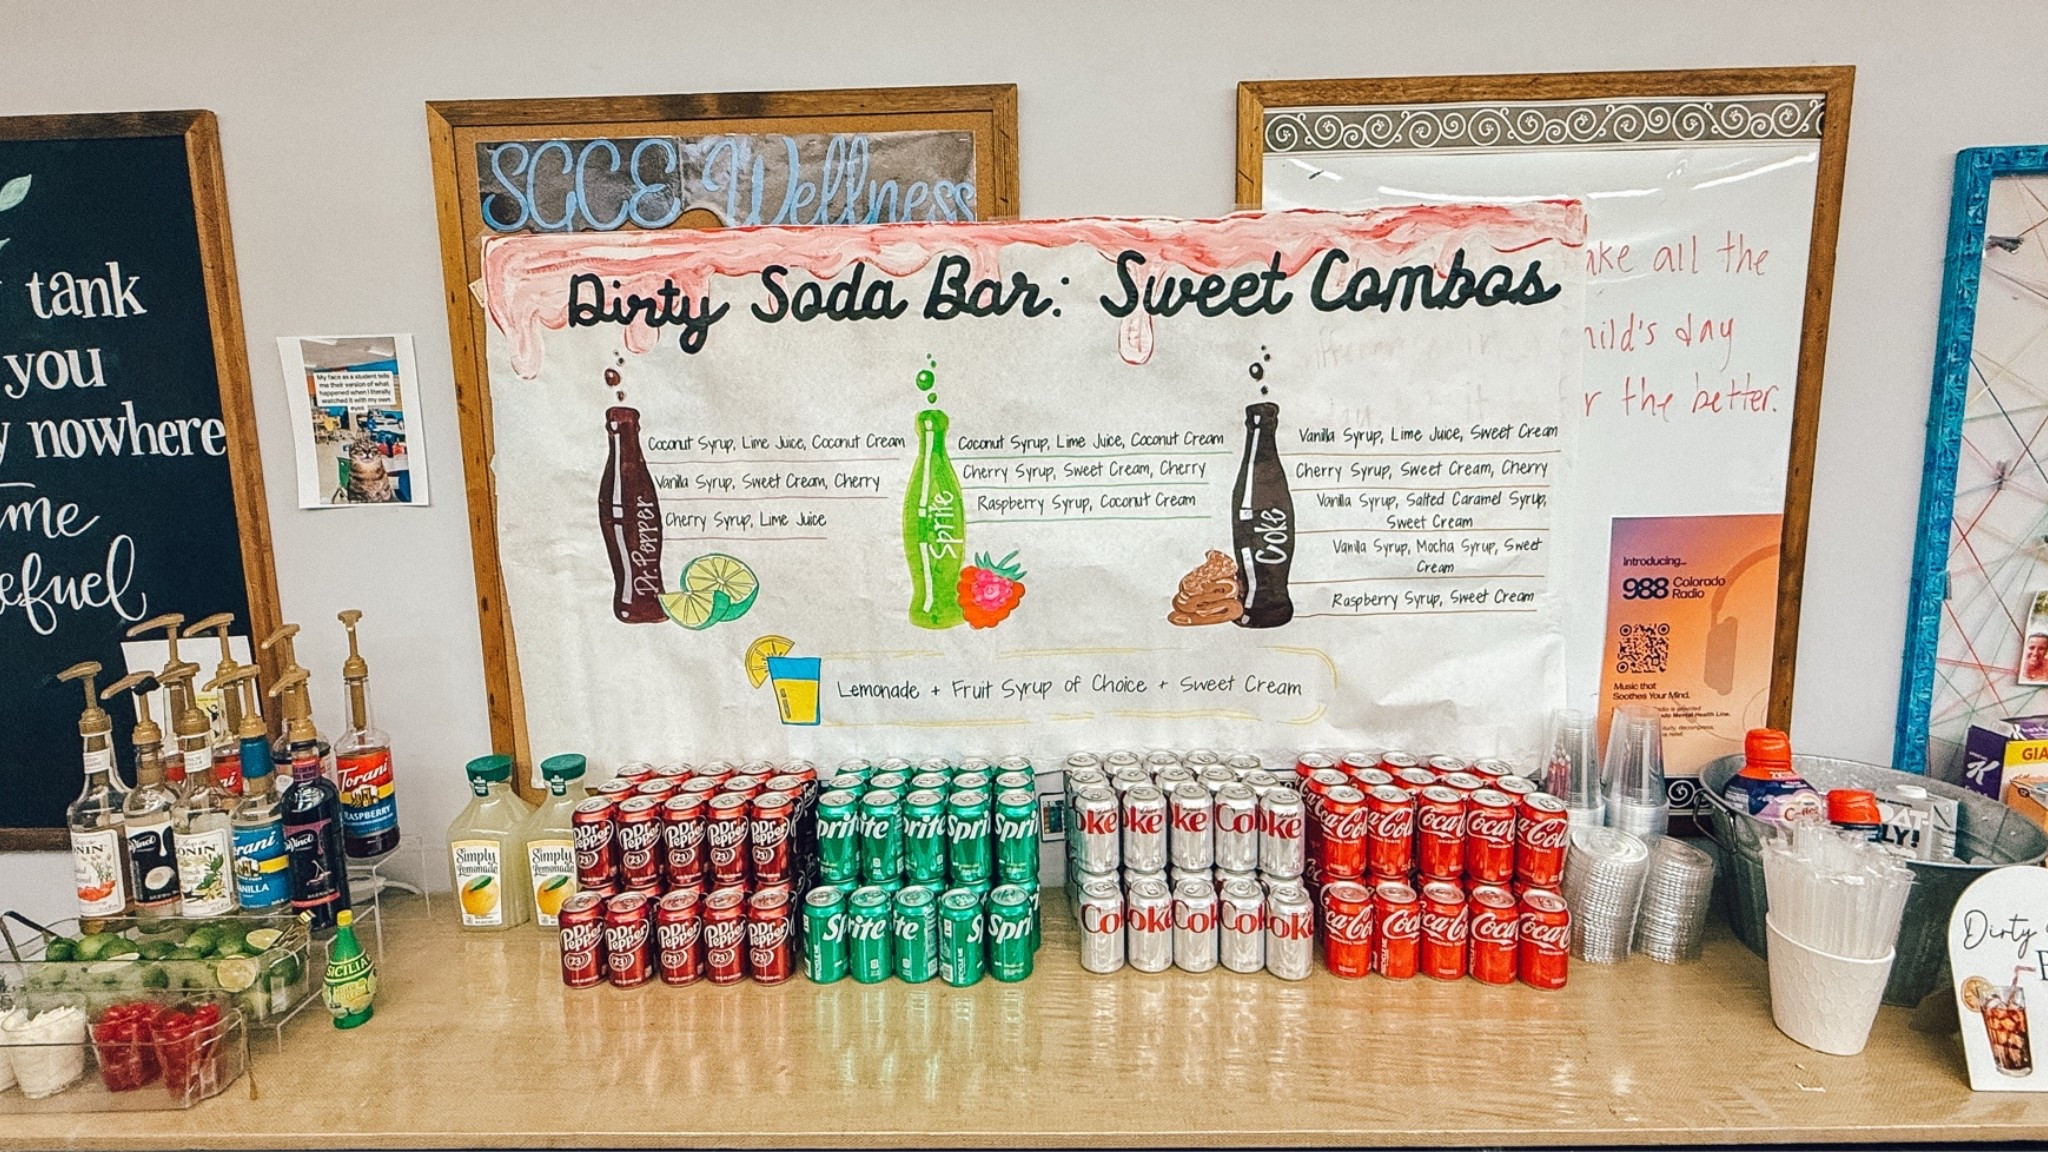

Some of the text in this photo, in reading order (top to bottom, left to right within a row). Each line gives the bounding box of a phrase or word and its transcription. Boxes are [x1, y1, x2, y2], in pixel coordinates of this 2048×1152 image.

[702, 134, 976, 228] Wellness
[1586, 231, 1769, 276] ake all the
[25, 262, 147, 319] tank
[569, 247, 1561, 354] Dirty Soda Bar: Sweet Combos
[1676, 314, 1734, 372] day
[4, 349, 107, 399] you
[1623, 373, 1779, 422] the better.
[27, 401, 226, 458] nowhere
[1299, 423, 1559, 449] Vanilla Syrup, Lime Juice, Sweet Cream
[648, 433, 906, 454] Coconut Syrup, Lime Juice, Coconut Cream
[958, 431, 1224, 452] Coconut Syrup, Lime Juice, Coconut Cream
[963, 460, 1206, 482] Cherry Syrup, Sweet Cream, Cherry
[1296, 459, 1548, 482] Cherry Syrup, Sweet Cream, Cherry
[655, 474, 880, 492] Vanilla Syrup, Sweet Cream, Cherry
[978, 492, 1195, 515] Raspberry Syrup, Coconut Cream
[1316, 490, 1547, 509] Vanilla Syrup, Salted Caramel Syrup,
[0, 497, 100, 538] me
[666, 511, 826, 531] Cherry Syrup, Lime Juice
[929, 490, 964, 560] Sprite
[1387, 514, 1473, 529] Sweet Cream
[631, 496, 660, 596] Dr. Pepper
[1254, 508, 1288, 565] Coke
[1333, 538, 1542, 555] Vanilla Syrup, Mocha Syrup, Sweet
[1417, 560, 1454, 574] Cream
[0, 535, 147, 635] efuel
[1623, 577, 1669, 599] 988
[1672, 588, 1704, 598] Radio
[1673, 576, 1726, 587] Colorado
[1332, 589, 1534, 610] Raspberry Syrup, Sweet Cream
[837, 680, 920, 699] Lemonade
[952, 678, 992, 699] Fruit
[1002, 679, 1052, 707] Syrup
[1065, 674, 1080, 693] of
[1092, 675, 1148, 694] Choice
[1181, 675, 1235, 692] Sweet
[1245, 674, 1302, 696] Cream
[1668, 691, 1690, 699] Mind.
[338, 758, 389, 792] Torani
[344, 804, 391, 820] RASPBERRY
[620, 822, 660, 850] Pepper
[632, 822, 651, 839] Dr
[707, 822, 746, 847] Pepper
[720, 821, 737, 837] Dr
[232, 832, 276, 855] rani
[456, 848, 497, 865] Simply
[532, 848, 572, 865] Simply
[457, 864, 498, 877] Lemonade
[533, 864, 574, 876] Lemonade
[1964, 910, 2037, 959] Dirty
